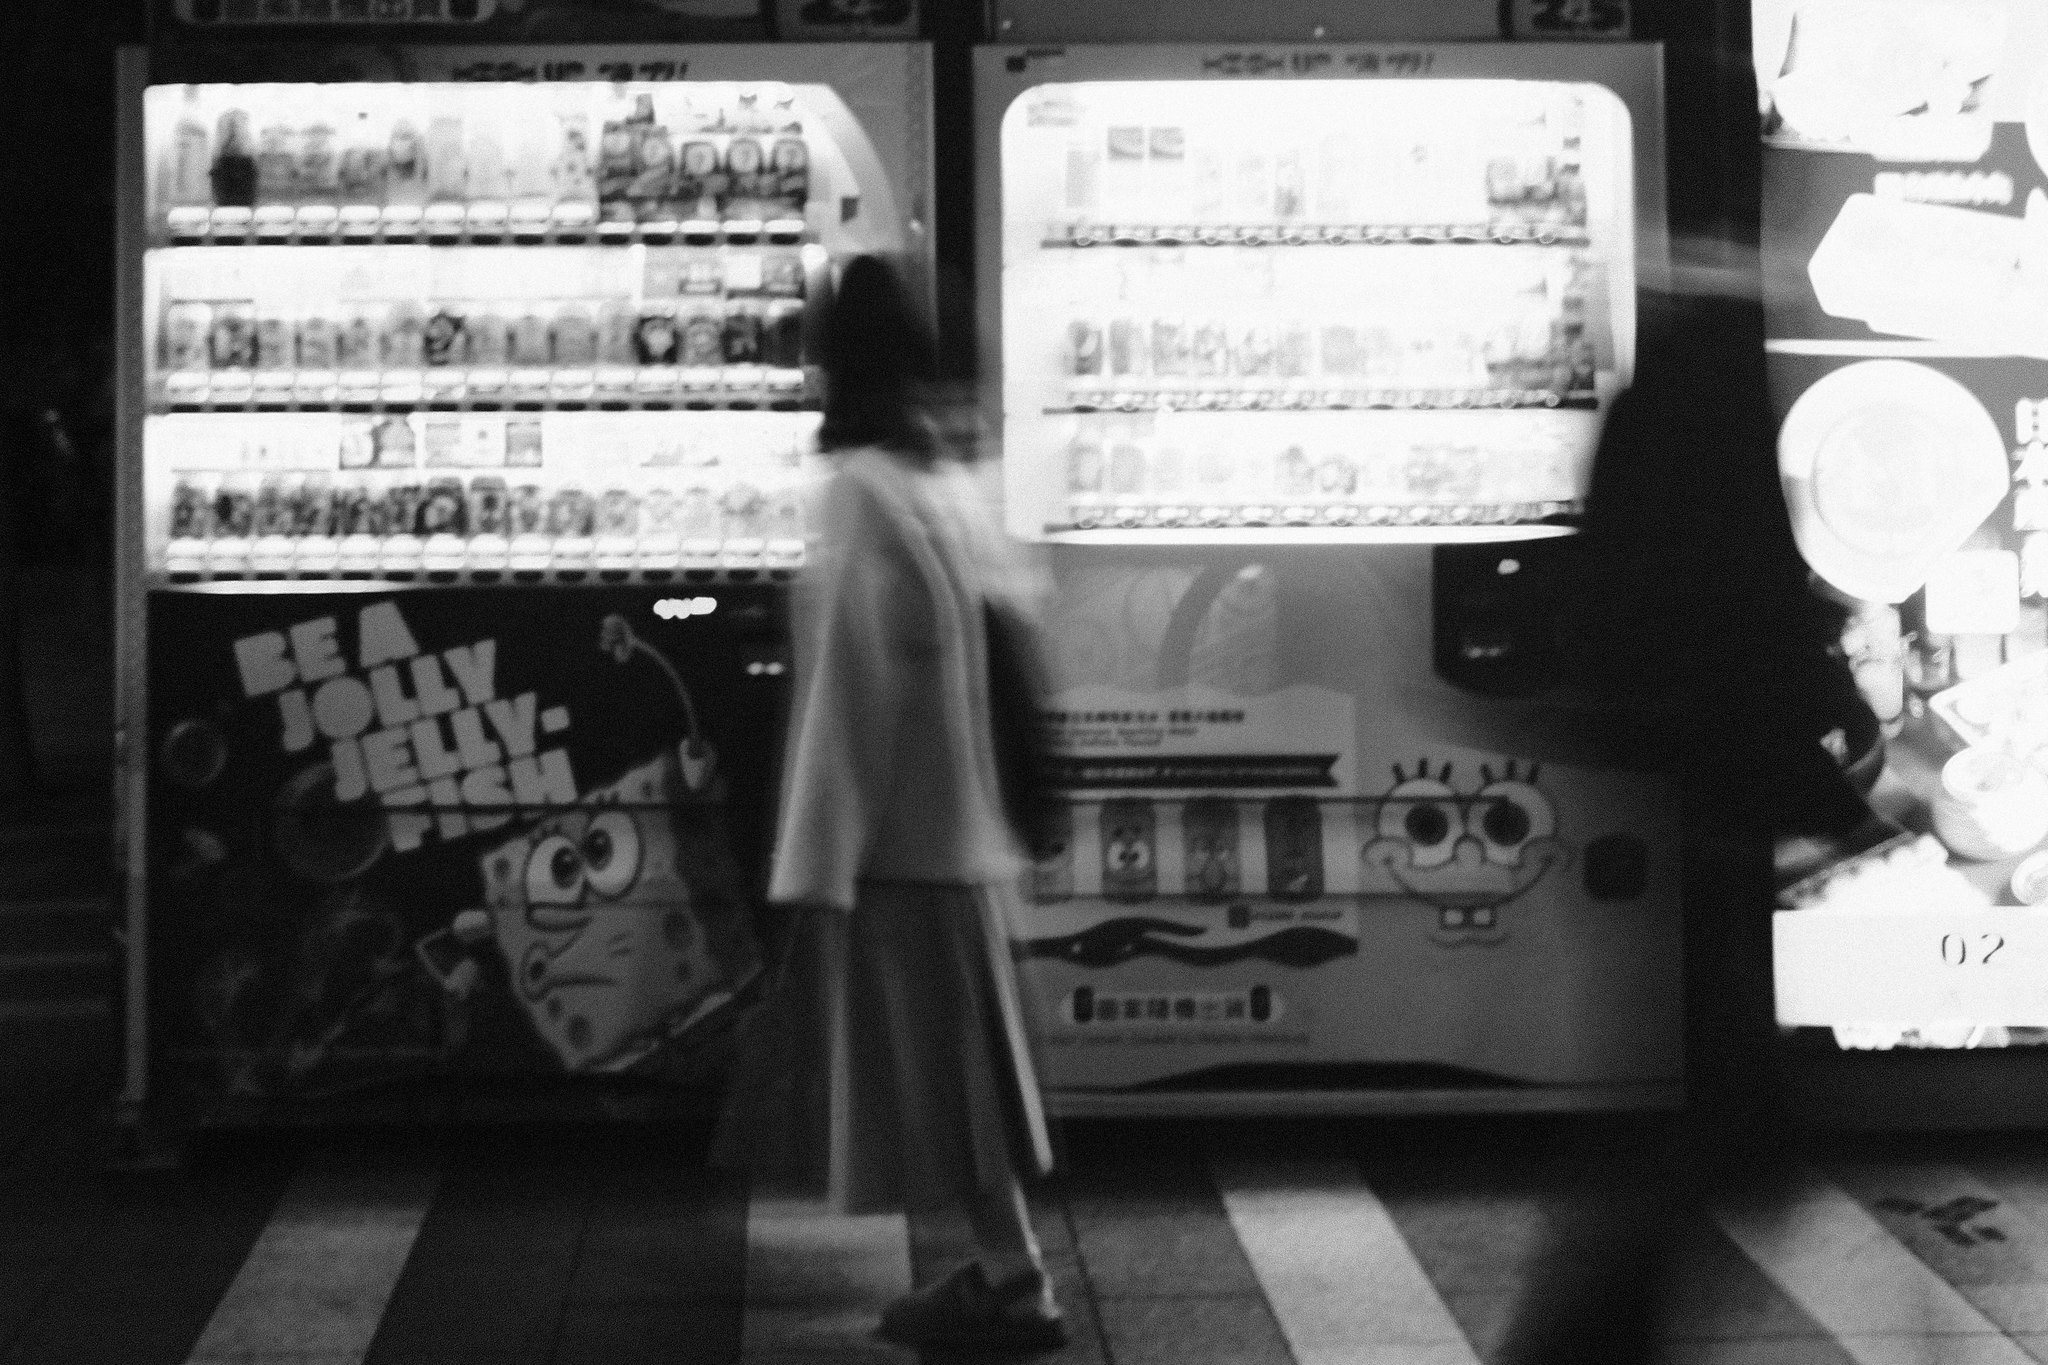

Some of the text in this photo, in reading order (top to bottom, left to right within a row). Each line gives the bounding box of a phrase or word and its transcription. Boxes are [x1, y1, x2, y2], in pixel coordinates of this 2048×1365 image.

[234, 600, 420, 697] BE A
[279, 638, 497, 752] JOLLY
[331, 691, 570, 802] JELLY-
[381, 748, 579, 853] FISH
